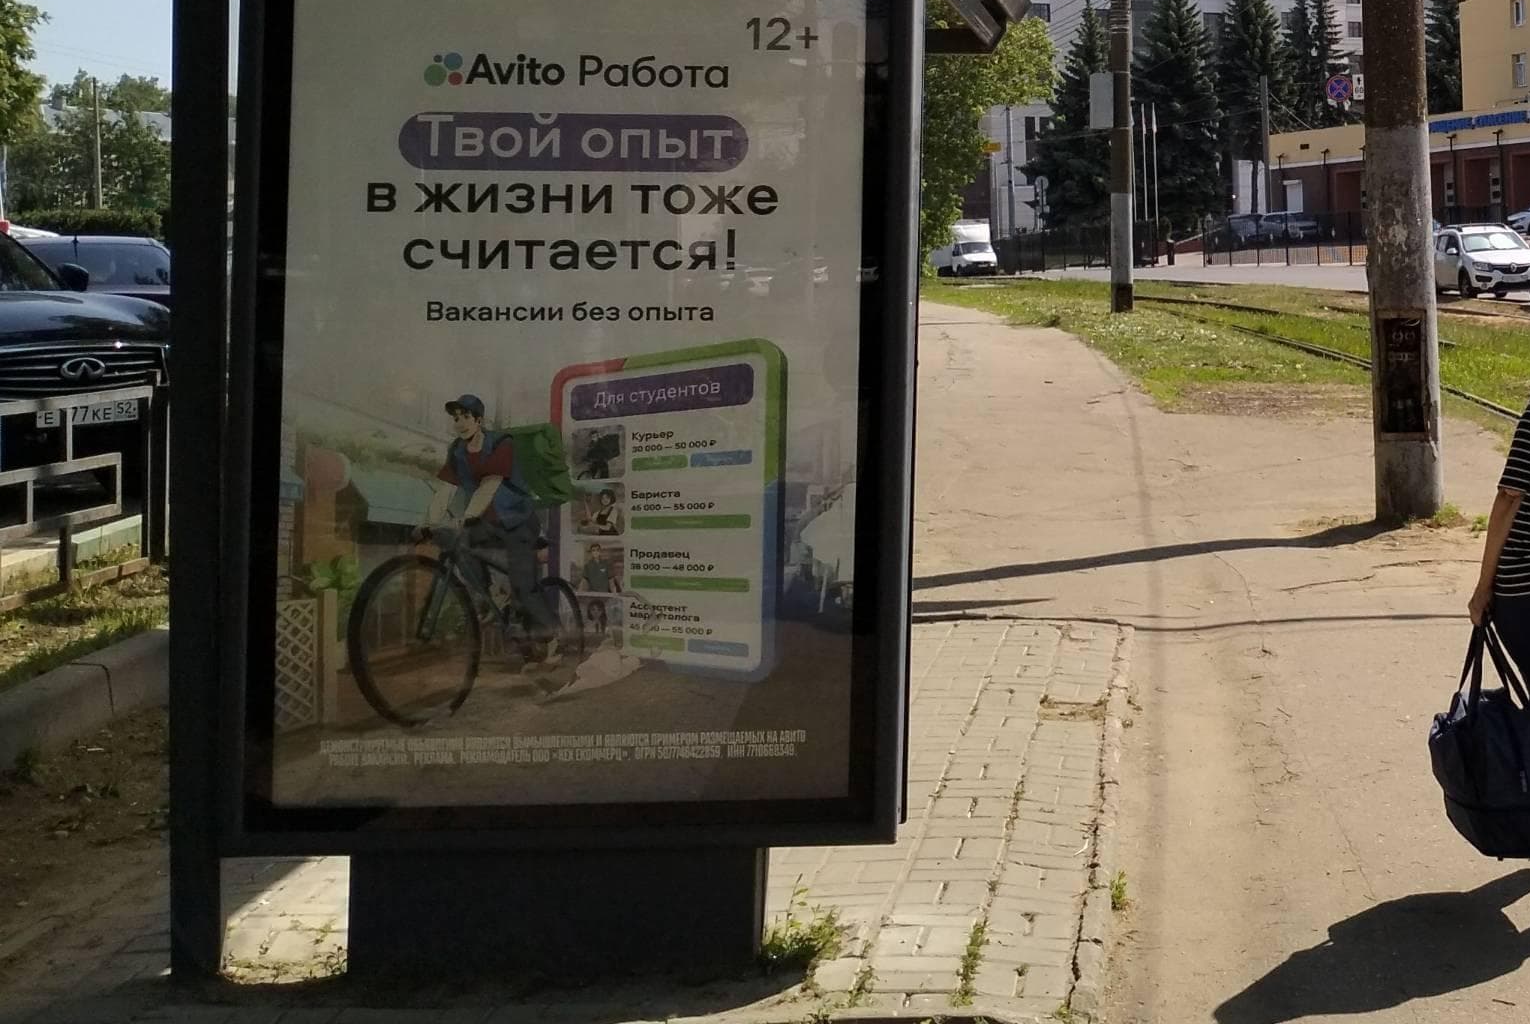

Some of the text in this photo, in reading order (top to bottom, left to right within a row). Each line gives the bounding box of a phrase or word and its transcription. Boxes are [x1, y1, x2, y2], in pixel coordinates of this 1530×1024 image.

[745, 16, 820, 52] 12+
[465, 52, 730, 89] Avito Работа
[417, 112, 733, 159] Твой опыт
[367, 183, 779, 215] в жизни тоже
[403, 228, 738, 272] считается!
[426, 301, 715, 323] Вакансии без опыта
[594, 380, 721, 409] Для студентов
[631, 430, 674, 443] Курьер
[688, 440, 708, 448] 000
[631, 490, 681, 501] Бариста
[630, 549, 690, 560] Продавец
[686, 564, 706, 572] 000
[630, 611, 700, 622] маретолога
